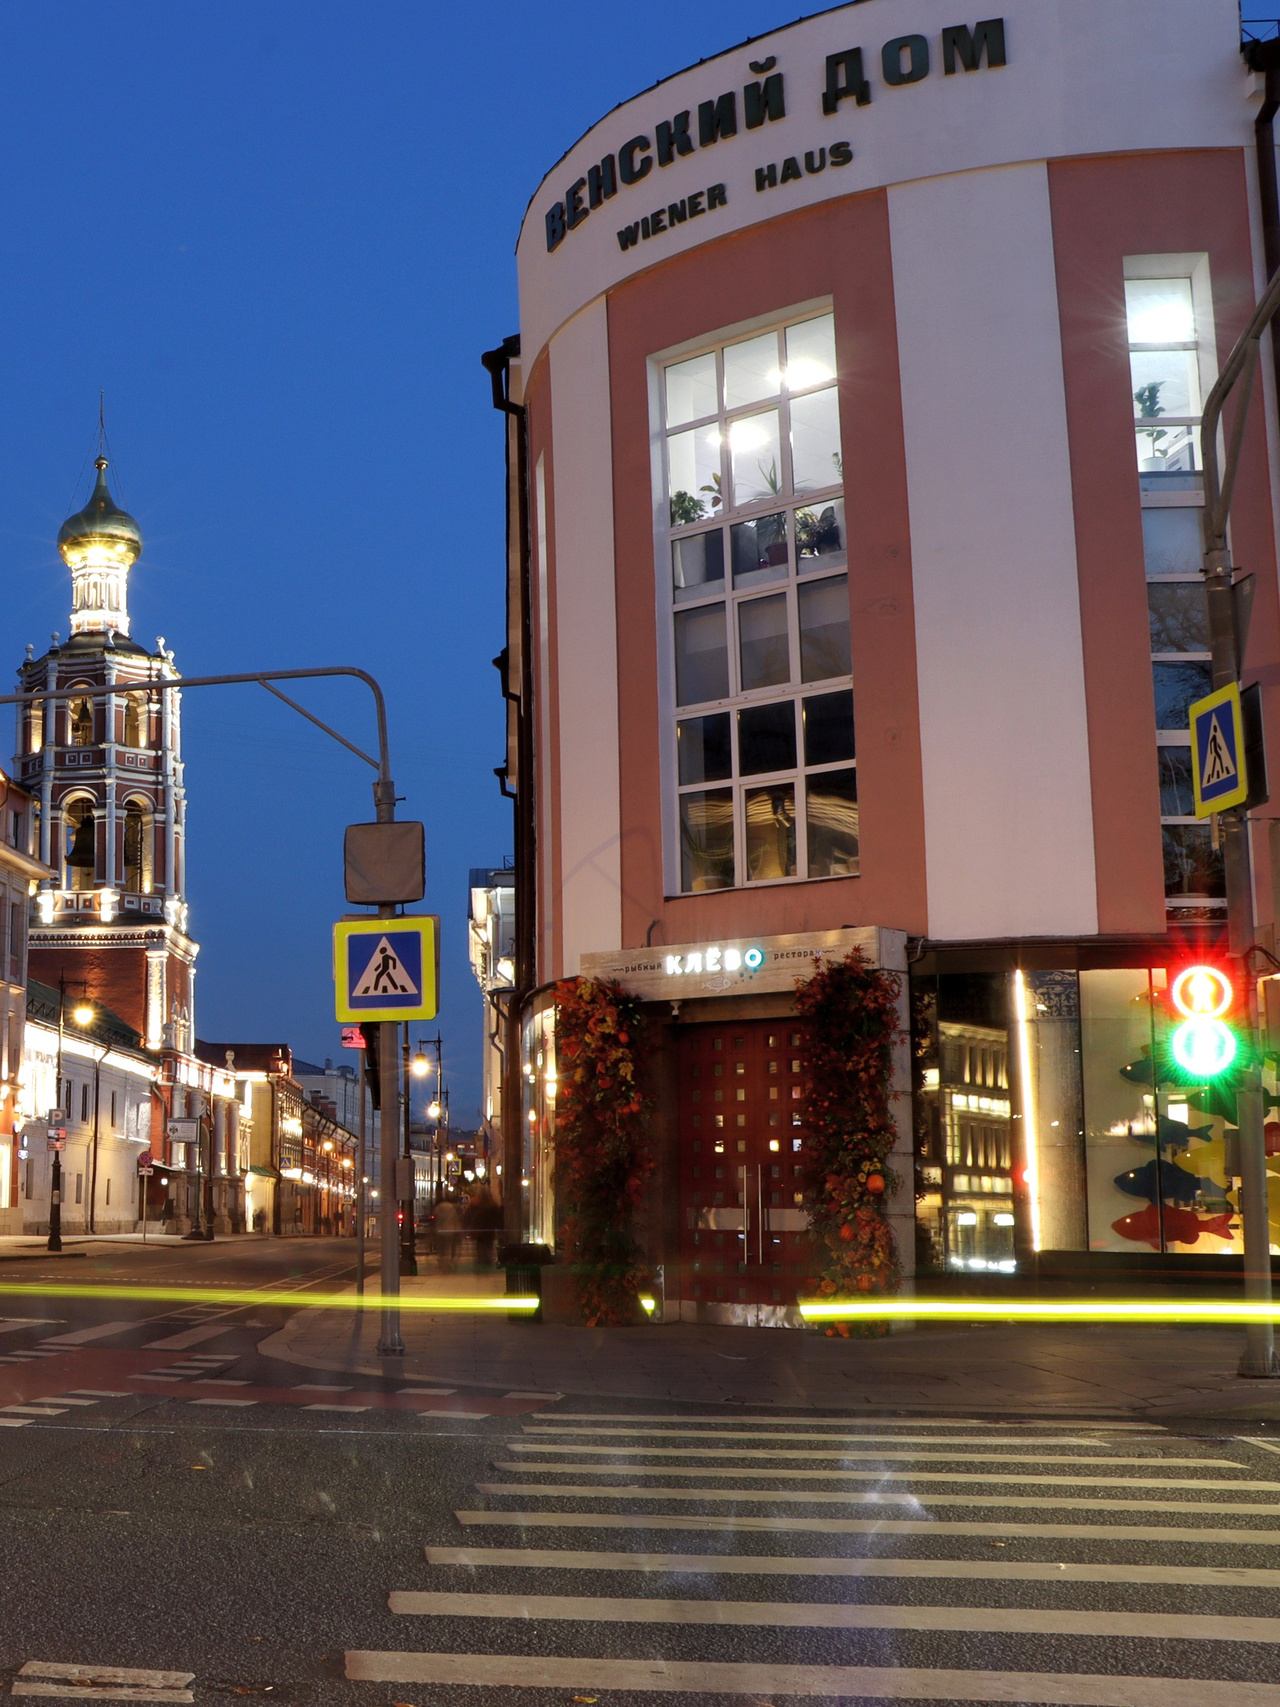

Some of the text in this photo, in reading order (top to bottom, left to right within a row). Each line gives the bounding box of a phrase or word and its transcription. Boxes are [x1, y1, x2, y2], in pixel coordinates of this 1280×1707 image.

[544, 17, 1007, 253] ВЕНСКИЙ ДОМ
[616, 141, 854, 252] WIENER HAUS
[625, 963, 662, 974] рыбный
[666, 947, 764, 975] КЛЁВО
